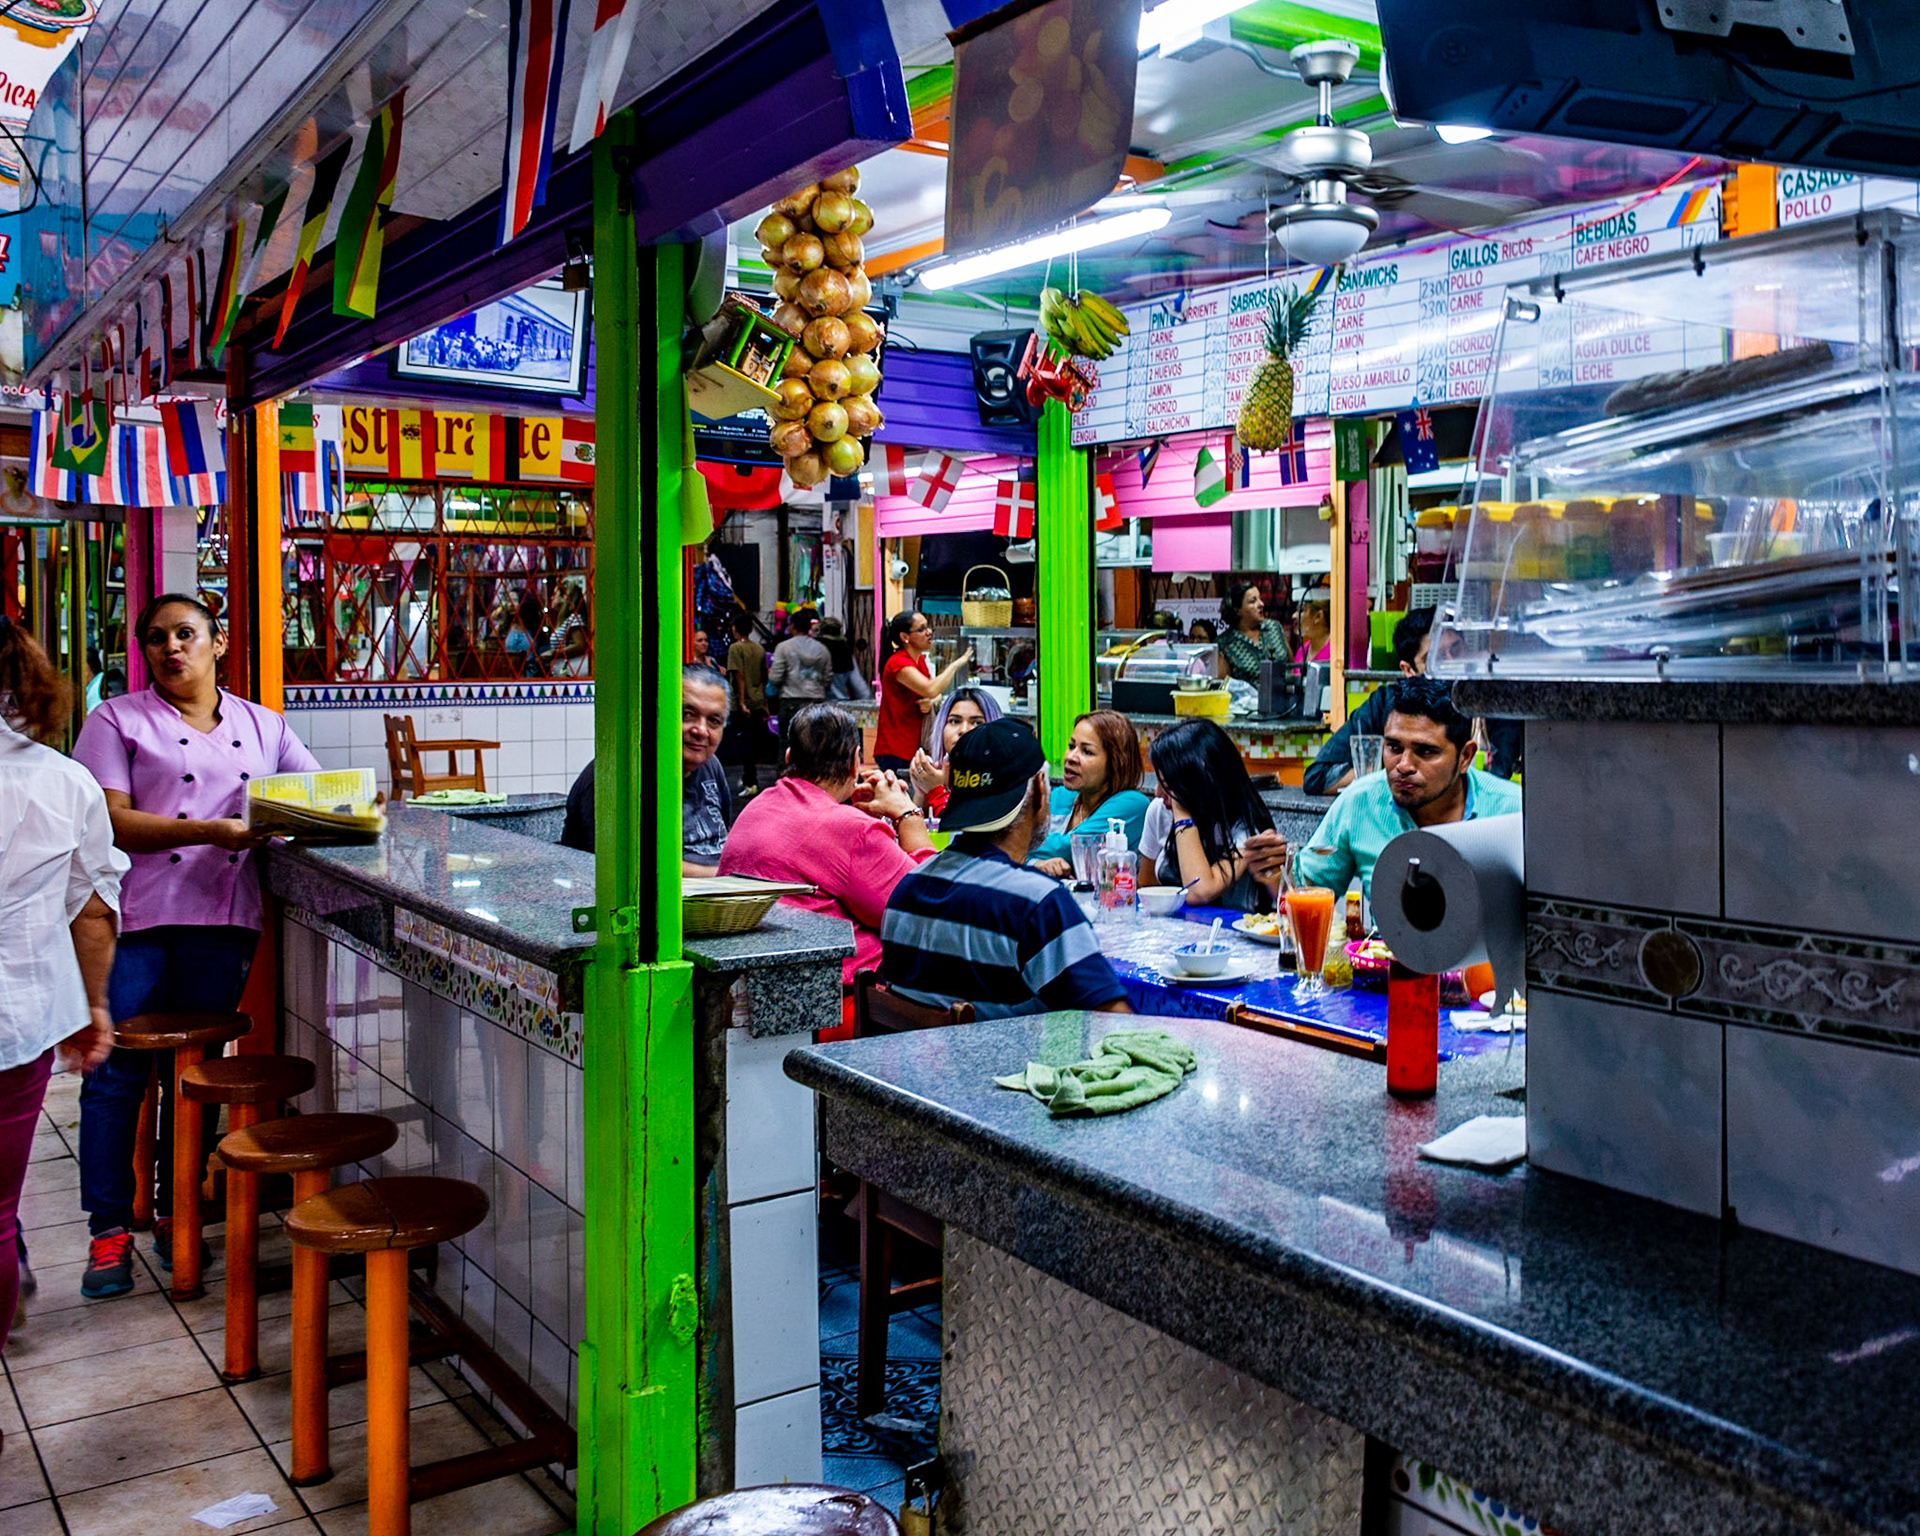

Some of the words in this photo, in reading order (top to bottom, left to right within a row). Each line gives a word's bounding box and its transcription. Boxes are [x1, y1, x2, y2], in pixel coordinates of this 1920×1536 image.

[1785, 194, 1832, 222] POLLO
[1576, 210, 1637, 244] BEBIDAS
[1451, 242, 1499, 270] GALLOS
[1502, 237, 1533, 260] RICOS
[1576, 245, 1605, 266] CAFE
[1607, 235, 1650, 259] NEGRO
[1338, 264, 1399, 293] SANDWICHS
[1450, 270, 1483, 291] POLLO
[1336, 292, 1366, 311] POLLO
[1450, 291, 1484, 312] CARNE
[1334, 313, 1365, 332] CARNE
[1150, 330, 1174, 346] CARNE
[1228, 333, 1252, 348] TORTA
[1333, 333, 1365, 352] JAMON
[1449, 334, 1493, 355] CHORIZO
[1575, 338, 1608, 360] AGUA
[1610, 334, 1651, 356] DULCE
[1154, 346, 1179, 360] HUEVO
[1228, 351, 1252, 367] TORTA
[1154, 363, 1183, 380] HUEVOS
[1330, 374, 1362, 392] QUESO
[1363, 367, 1411, 388] AMARILLO
[1575, 362, 1613, 383] LECHE
[1148, 383, 1173, 399] JAMON
[1147, 400, 1178, 416] CHORIZO
[1330, 394, 1367, 412] LENGUA
[1072, 413, 1090, 427] FILET
[1147, 416, 1191, 434] SALCHICHON
[1072, 430, 1097, 444] LENGUA
[953, 768, 981, 788] Yale
